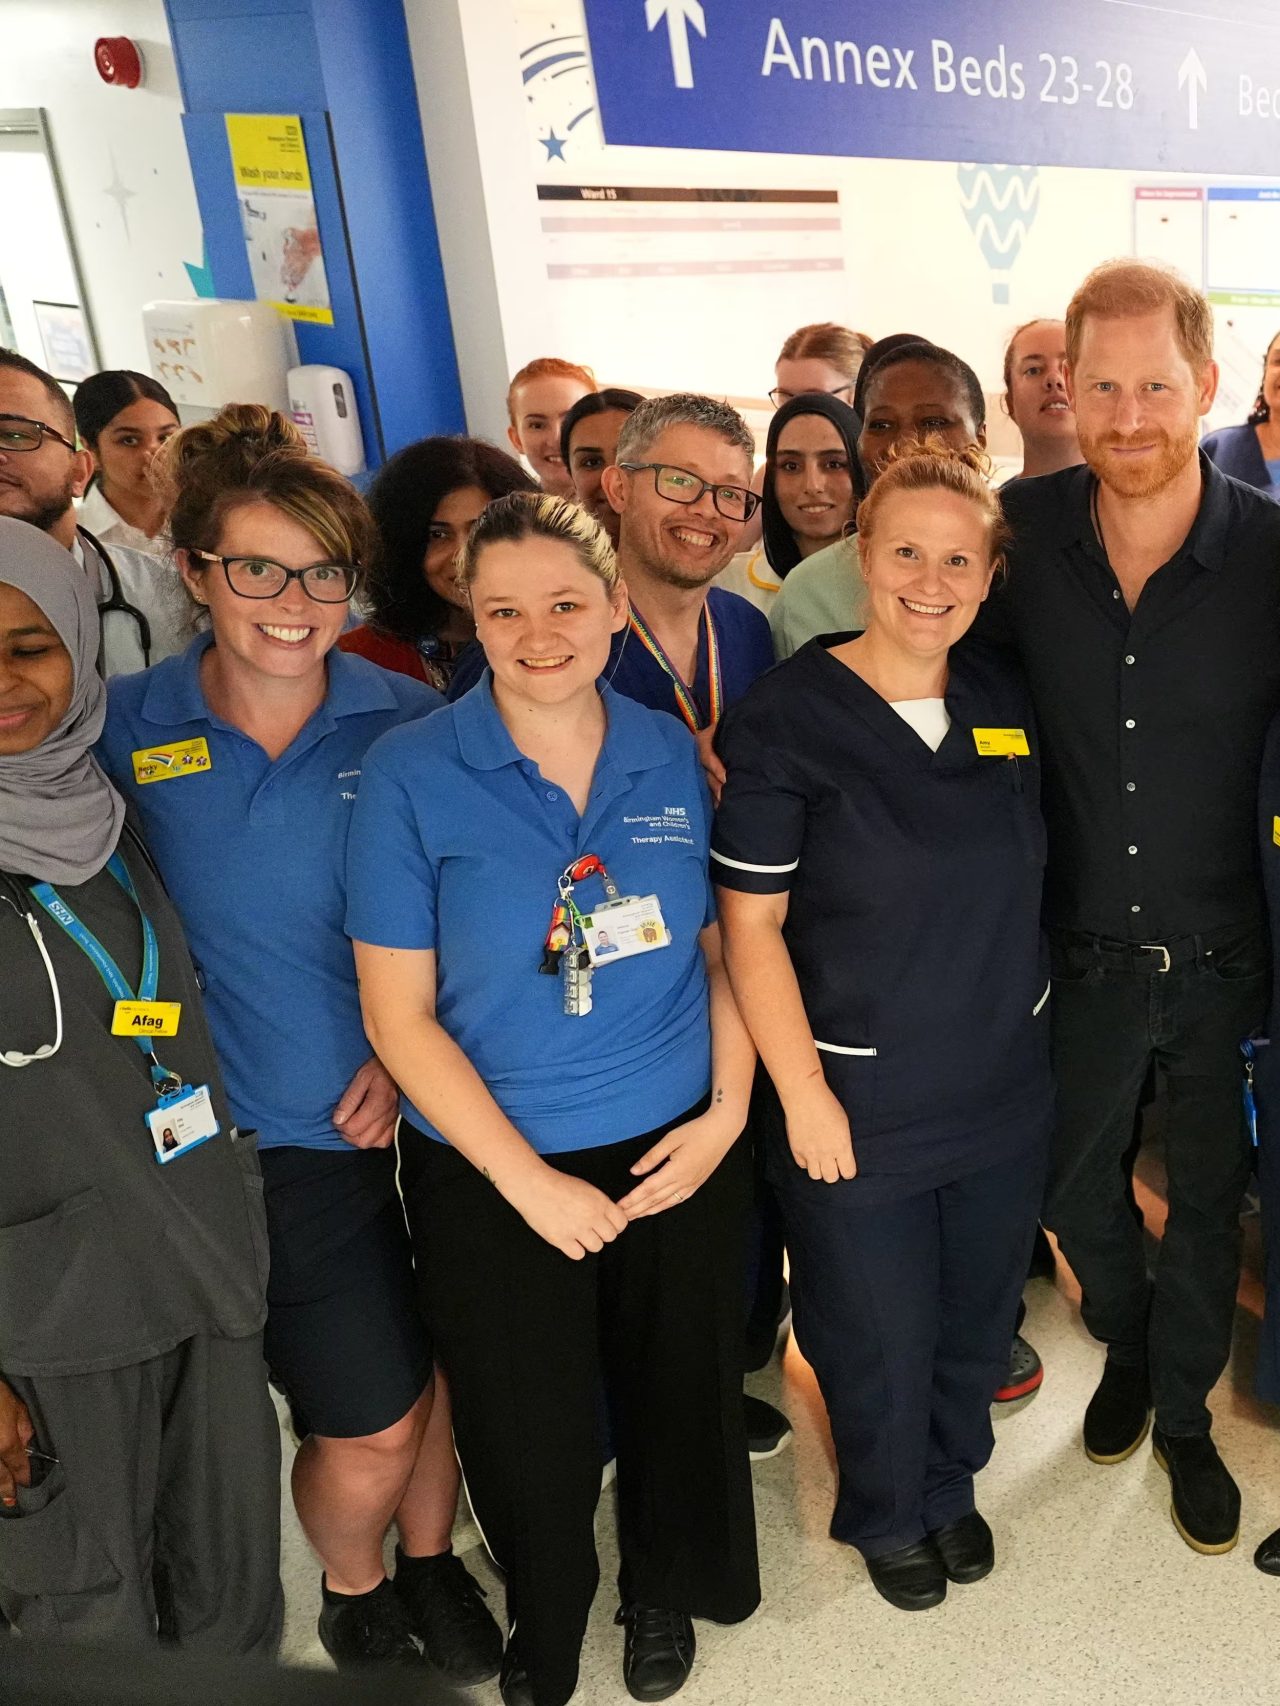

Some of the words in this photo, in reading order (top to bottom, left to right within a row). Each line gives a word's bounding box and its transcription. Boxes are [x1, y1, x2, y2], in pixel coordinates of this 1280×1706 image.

[761, 17, 918, 91] Annex
[931, 39, 1026, 100] Beds
[1038, 52, 1134, 110] 23-28
[580, 187, 605, 200] Ward
[664, 806, 687, 816] NHS
[623, 815, 661, 823] Birmingham
[630, 836, 662, 844] Therapy
[50, 901, 74, 925] NHS
[132, 1015, 163, 1029] Afag
